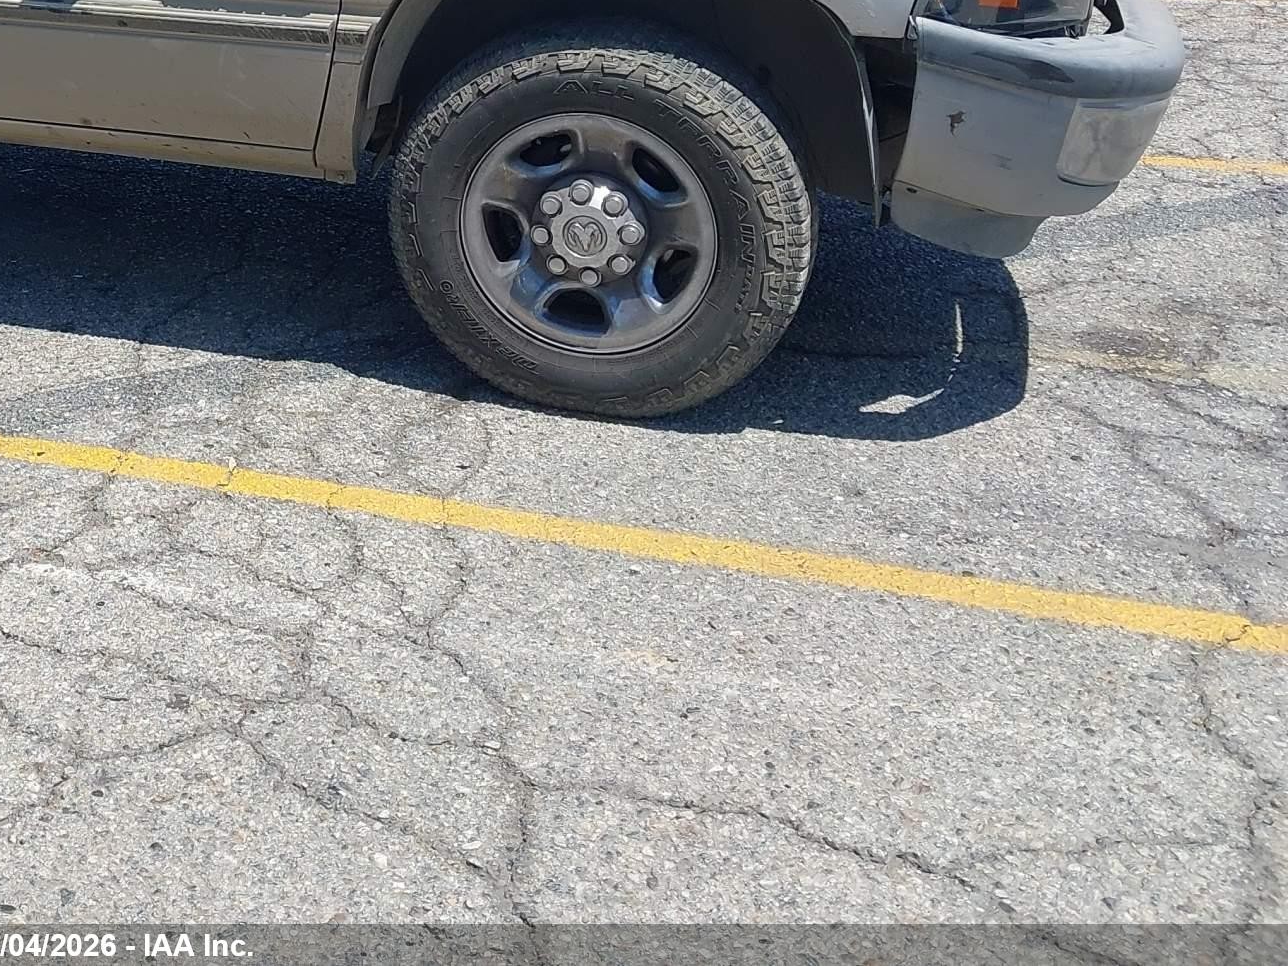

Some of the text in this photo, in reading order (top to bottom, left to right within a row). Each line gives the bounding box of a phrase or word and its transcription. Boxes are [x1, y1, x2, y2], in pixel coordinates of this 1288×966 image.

[553, 79, 756, 264] ALL TERRAIN
[439, 279, 541, 375] DEXTERO
